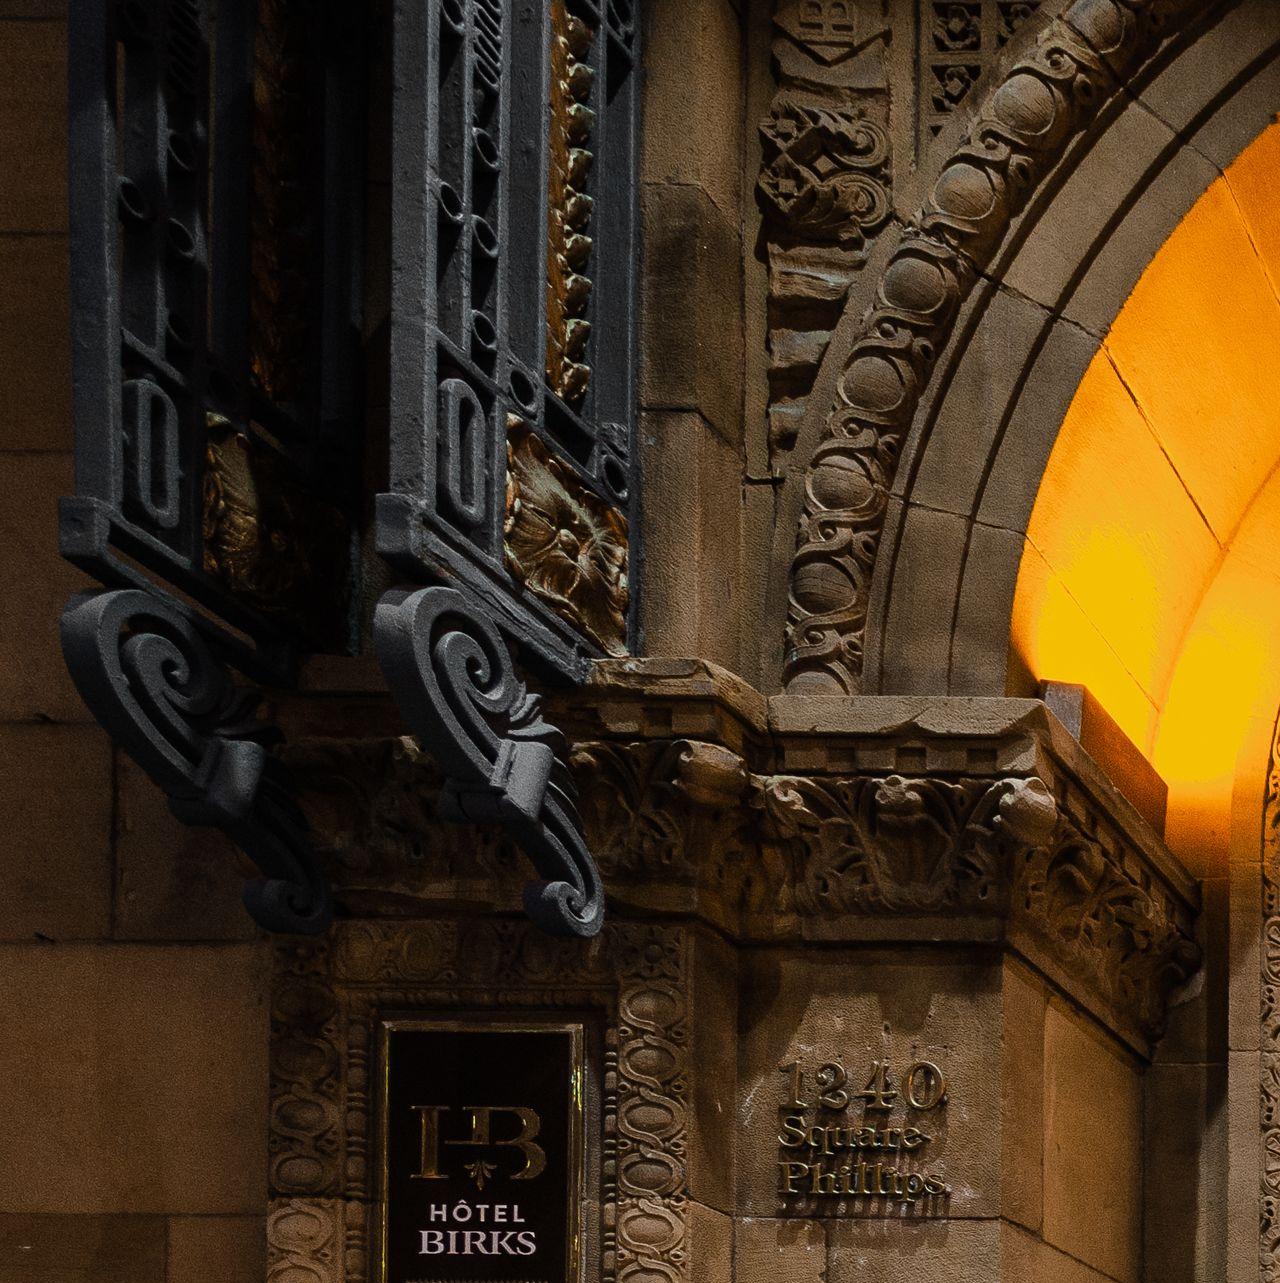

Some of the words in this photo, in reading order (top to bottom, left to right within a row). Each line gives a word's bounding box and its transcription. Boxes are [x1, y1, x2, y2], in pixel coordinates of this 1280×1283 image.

[778, 1060, 948, 1110] 1240
[778, 1116, 930, 1155] Square
[778, 1161, 948, 1202] Phillips
[430, 1200, 527, 1224] HÔTEL
[418, 1230, 537, 1256] BIRKS
